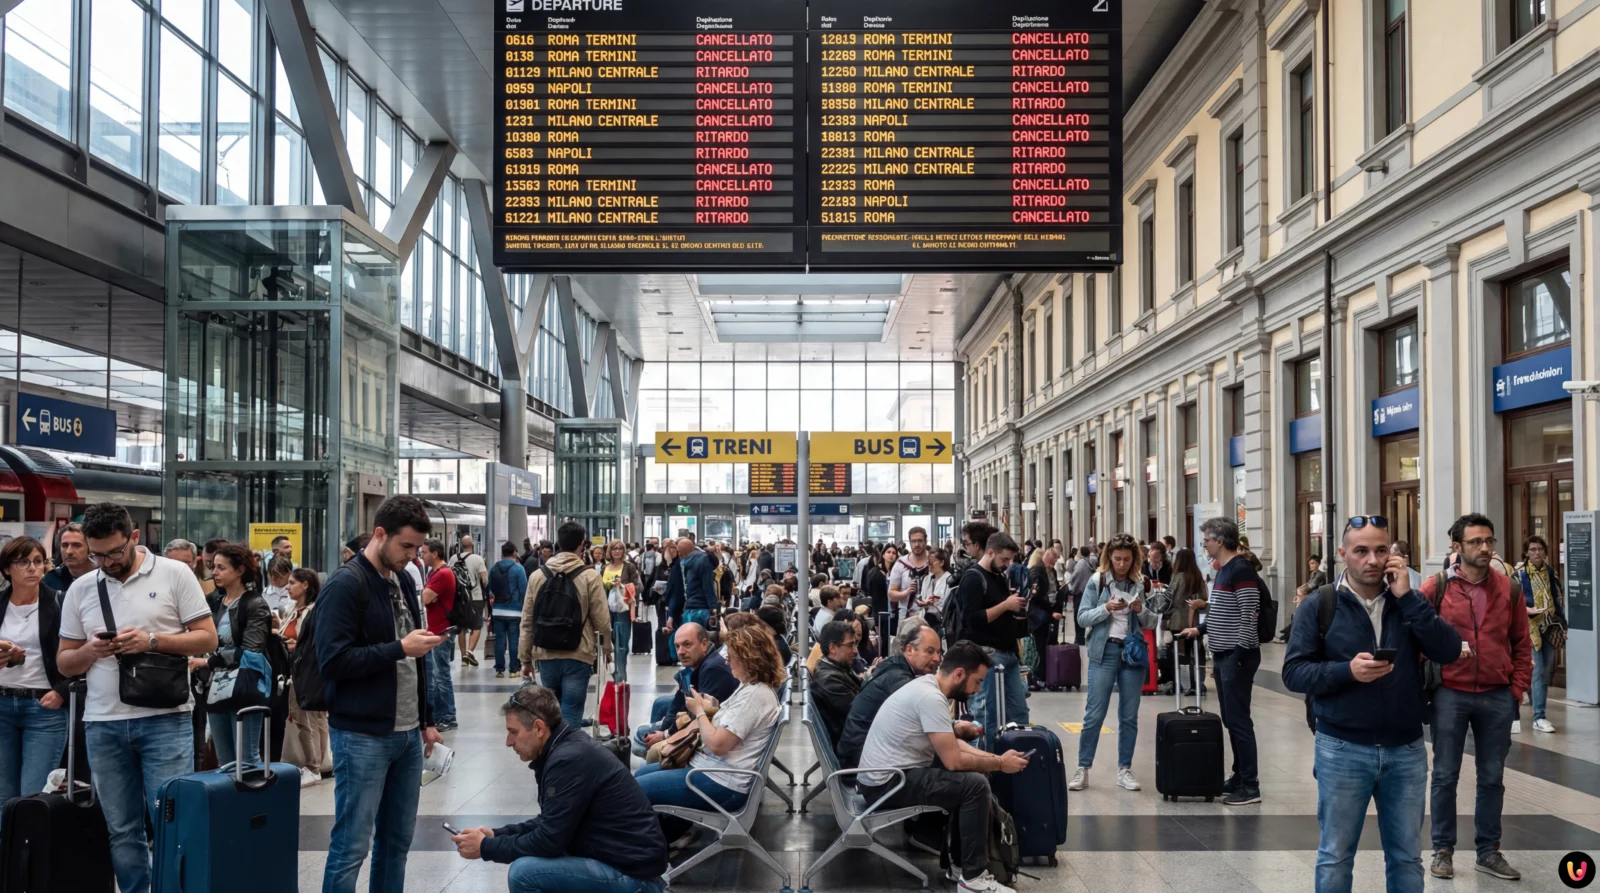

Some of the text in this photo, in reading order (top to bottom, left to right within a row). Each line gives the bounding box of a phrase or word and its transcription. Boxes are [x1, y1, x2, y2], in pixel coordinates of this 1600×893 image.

[531, 0, 623, 11] DEPARTURE
[547, 34, 580, 47] ROMA
[585, 34, 637, 47] TERMINI
[695, 34, 773, 46] CANCELLATO
[863, 33, 896, 46] ROMA
[901, 33, 953, 46] TERMINI
[1012, 33, 1090, 45] CANCELLATO
[547, 50, 580, 63] ROMA
[585, 50, 637, 63] TERMINI
[695, 50, 773, 62] CANCELLATO
[863, 49, 896, 62] ROMA
[901, 49, 953, 62] TERMINI
[1012, 49, 1090, 61] CANCELLATO
[547, 66, 593, 79] MILANO
[597, 66, 659, 79] CENTRALE
[695, 66, 749, 78] RITARDO
[863, 65, 909, 78] MILANO
[913, 65, 975, 78] CENTRALE
[1012, 65, 1066, 77] RITARDO
[547, 82, 593, 95] NAPOLI
[695, 82, 773, 94] CANCELLATO
[863, 81, 896, 94] ROMA
[901, 81, 953, 94] TERMINI
[1012, 81, 1090, 93] CANCELLATO
[547, 98, 580, 111] ROMA
[585, 98, 637, 111] TERMINI
[695, 98, 773, 110] CANCELLATO
[863, 97, 909, 110] MILANO
[913, 97, 975, 110] CENTRALE
[1012, 97, 1066, 109] RITARDO
[505, 114, 773, 127] 1231 MILANO CENTRALE CANCELLATO
[863, 113, 909, 126] NAPOLI
[1012, 113, 1090, 125] CANCELLATO
[547, 131, 580, 144] ROMA
[695, 131, 749, 143] RITARDO
[863, 130, 896, 143] ROMA
[1012, 130, 1090, 142] CANCELLATO
[547, 147, 593, 160] NAPOLI
[695, 147, 749, 159] RITARDO
[863, 146, 909, 159] MILANO
[913, 146, 975, 159] CENTRALE
[1012, 146, 1066, 158] RITARDO
[547, 163, 580, 176] ROMA
[695, 163, 773, 175] CANCELLATO
[863, 162, 909, 175] MILANO
[913, 162, 975, 175] CENTRALE
[1012, 162, 1066, 174] RITARDO
[547, 179, 580, 192] ROMA
[585, 179, 637, 192] TERMINI
[695, 179, 773, 191] CANCELLATO
[863, 178, 896, 191] ROMA
[1012, 178, 1090, 190] CANCELLATO
[547, 195, 593, 208] MILANO
[597, 195, 659, 208] CENTRALE
[695, 195, 749, 207] RITARDO
[863, 194, 909, 207] NAPOLI
[1012, 194, 1066, 206] RITARDO
[547, 211, 593, 224] MILANO
[597, 211, 659, 224] CENTRALE
[695, 211, 749, 223] RITARDO
[863, 210, 896, 223] ROMA
[1012, 210, 1090, 222] CANCELLATO
[53, 416, 72, 433] BUS
[712, 438, 772, 455] TRENI
[854, 438, 895, 455] BUS
